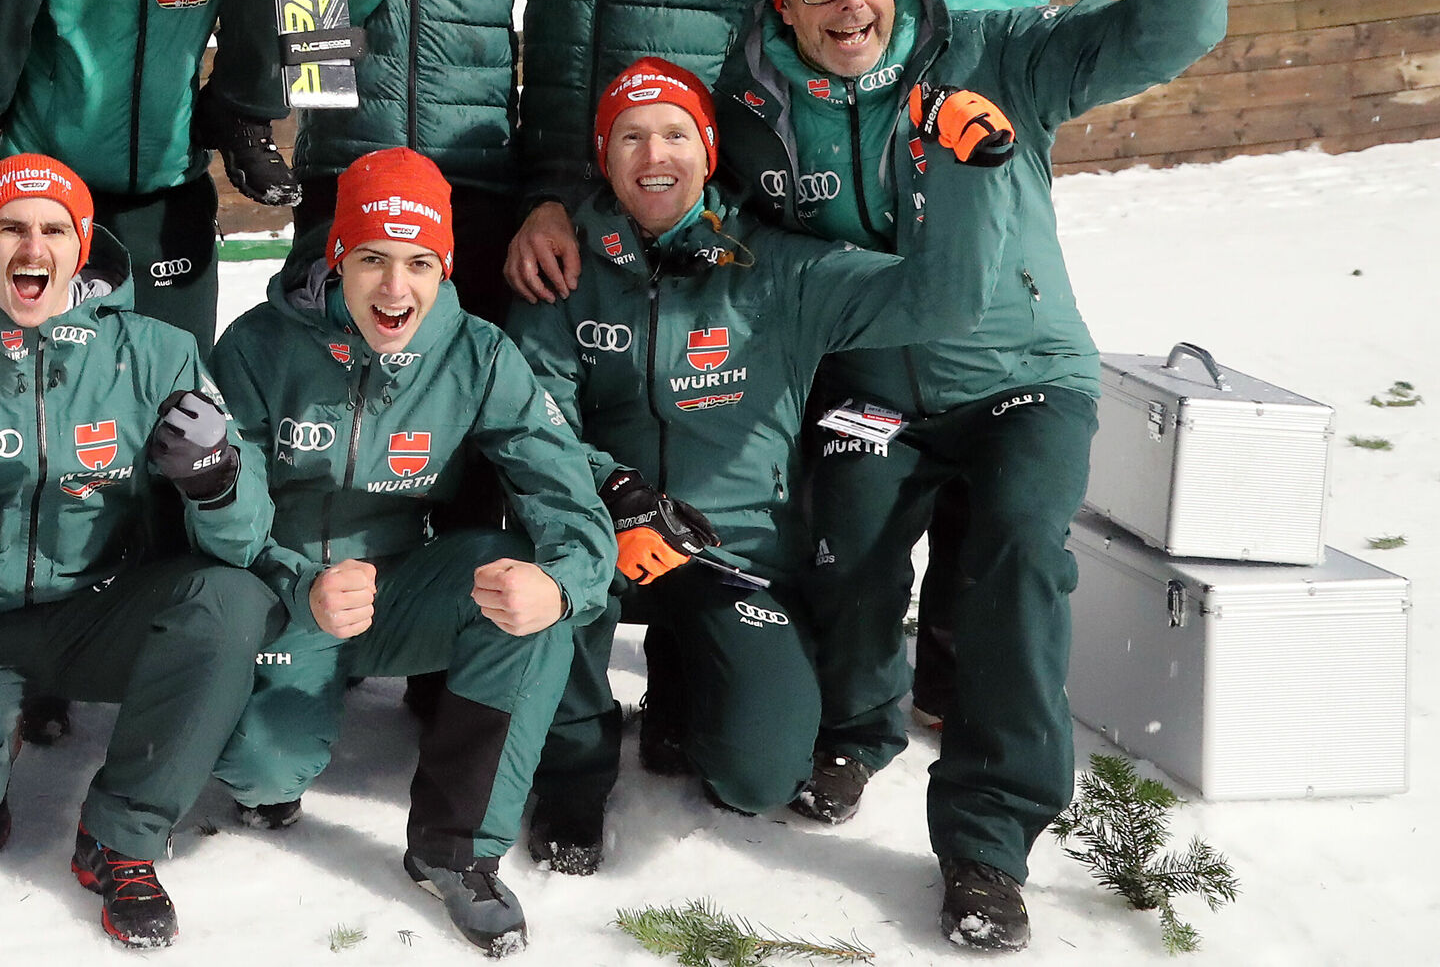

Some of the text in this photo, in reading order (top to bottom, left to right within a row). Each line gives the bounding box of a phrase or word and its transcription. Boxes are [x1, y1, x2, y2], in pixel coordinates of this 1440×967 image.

[361, 196, 442, 225] VIESSMANN
[154, 279, 173, 287] Audi
[670, 367, 747, 393] WÜRTH
[192, 449, 223, 471] SEIZ
[367, 472, 438, 494] WÜRTH
[740, 616, 763, 628] Audi
